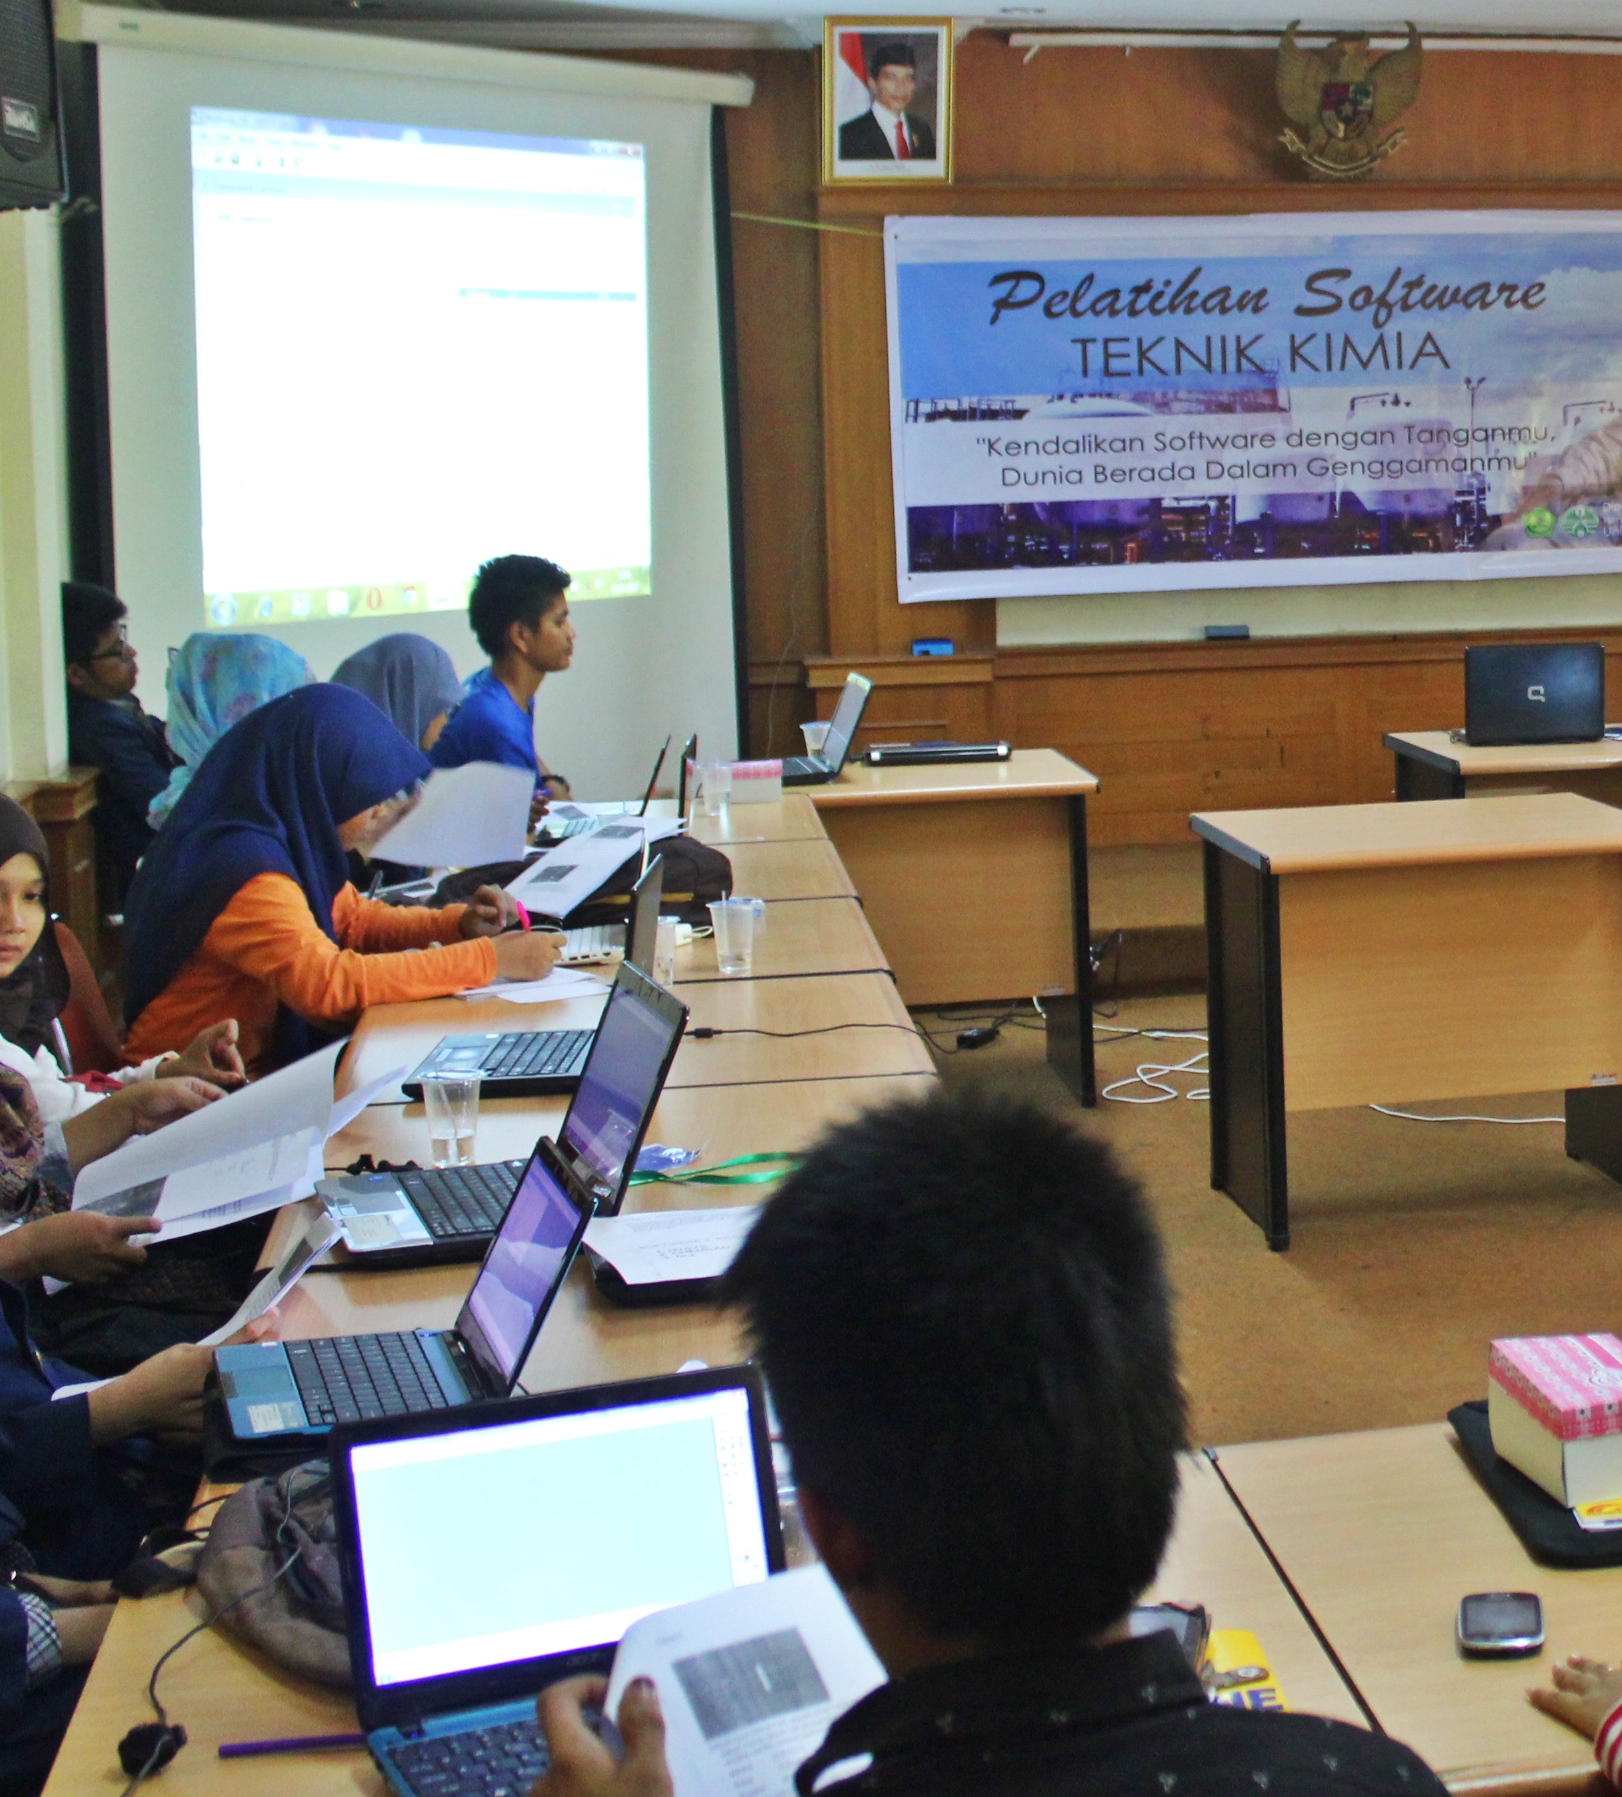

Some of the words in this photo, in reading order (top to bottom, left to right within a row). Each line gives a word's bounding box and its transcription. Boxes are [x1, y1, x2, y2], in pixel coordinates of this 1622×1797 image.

[988, 266, 1270, 326] Pelatihan
[1293, 266, 1547, 329] Software
[1070, 333, 1267, 378] TEKNIK
[1289, 331, 1450, 372] KIMIA
[976, 433, 1145, 457] "Kendalikan
[1153, 430, 1276, 452] Software
[1285, 427, 1396, 451] dengan
[1403, 424, 1556, 448] Tanganmu,
[1001, 465, 1083, 487] Dunia
[1093, 461, 1195, 484] Berada
[1205, 459, 1297, 481] Dalam
[1306, 451, 1537, 481] Genggamanmu"
